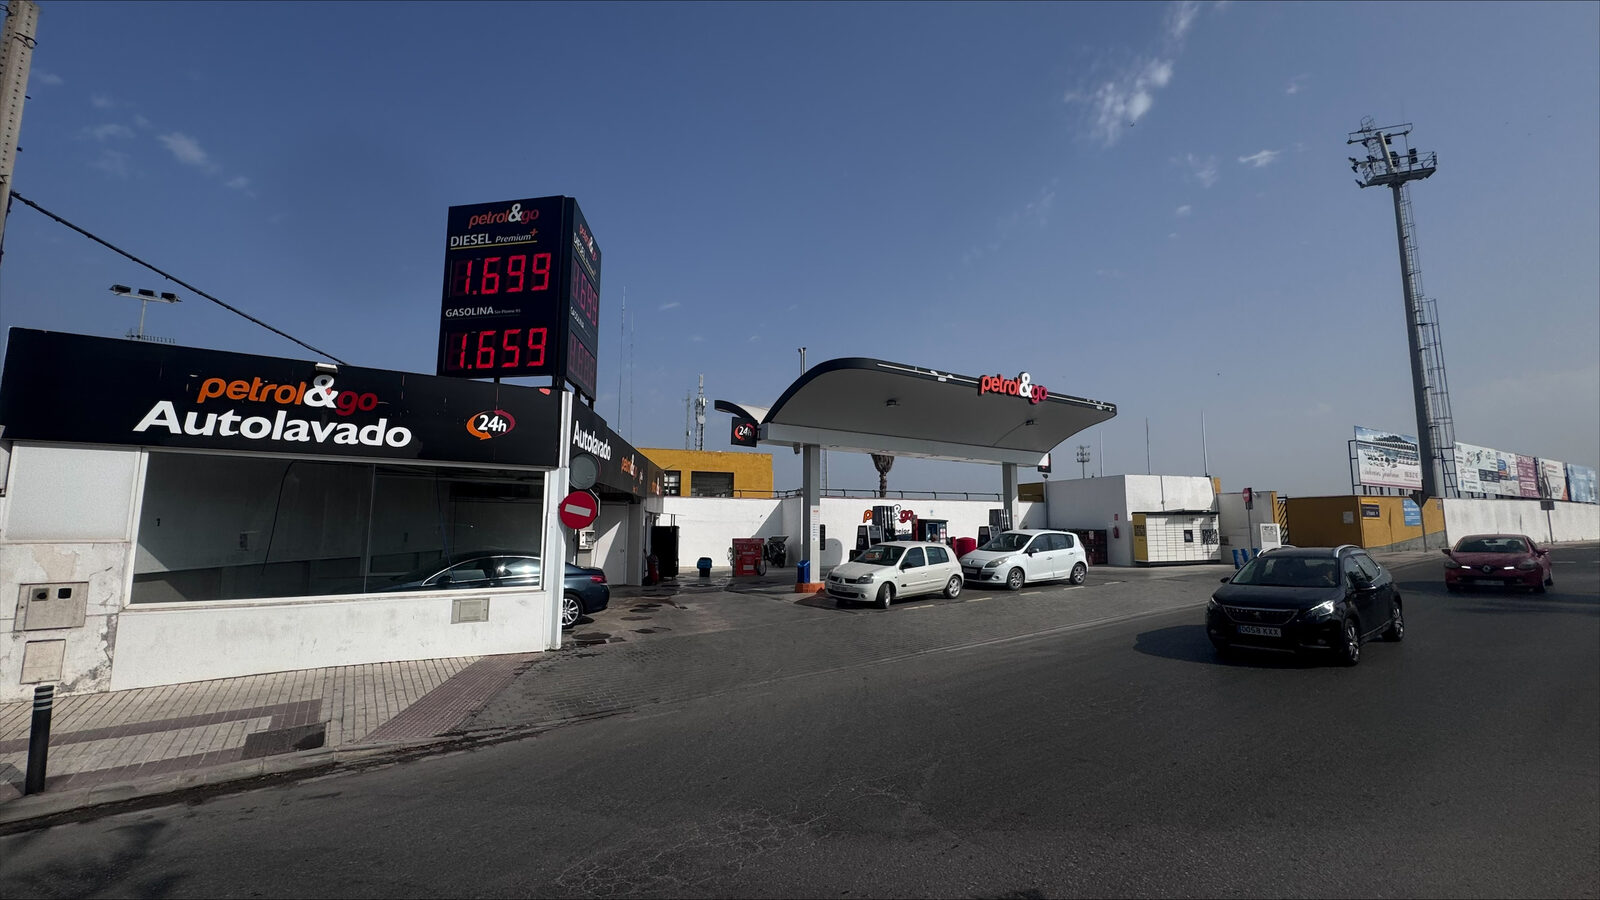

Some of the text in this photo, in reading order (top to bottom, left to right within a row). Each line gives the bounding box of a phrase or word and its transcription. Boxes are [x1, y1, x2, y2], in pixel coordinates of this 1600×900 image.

[468, 203, 539, 229] petrol&go
[450, 233, 491, 247] DIESEL
[464, 252, 551, 295] 1.699
[445, 306, 494, 318] GASOLINA
[459, 327, 548, 370] 1.659
[196, 374, 379, 417] petrol&go
[980, 372, 1048, 404] petrol&go
[132, 400, 412, 448] Autolavado
[477, 415, 507, 433] 24h
[573, 420, 611, 460] Autolavado
